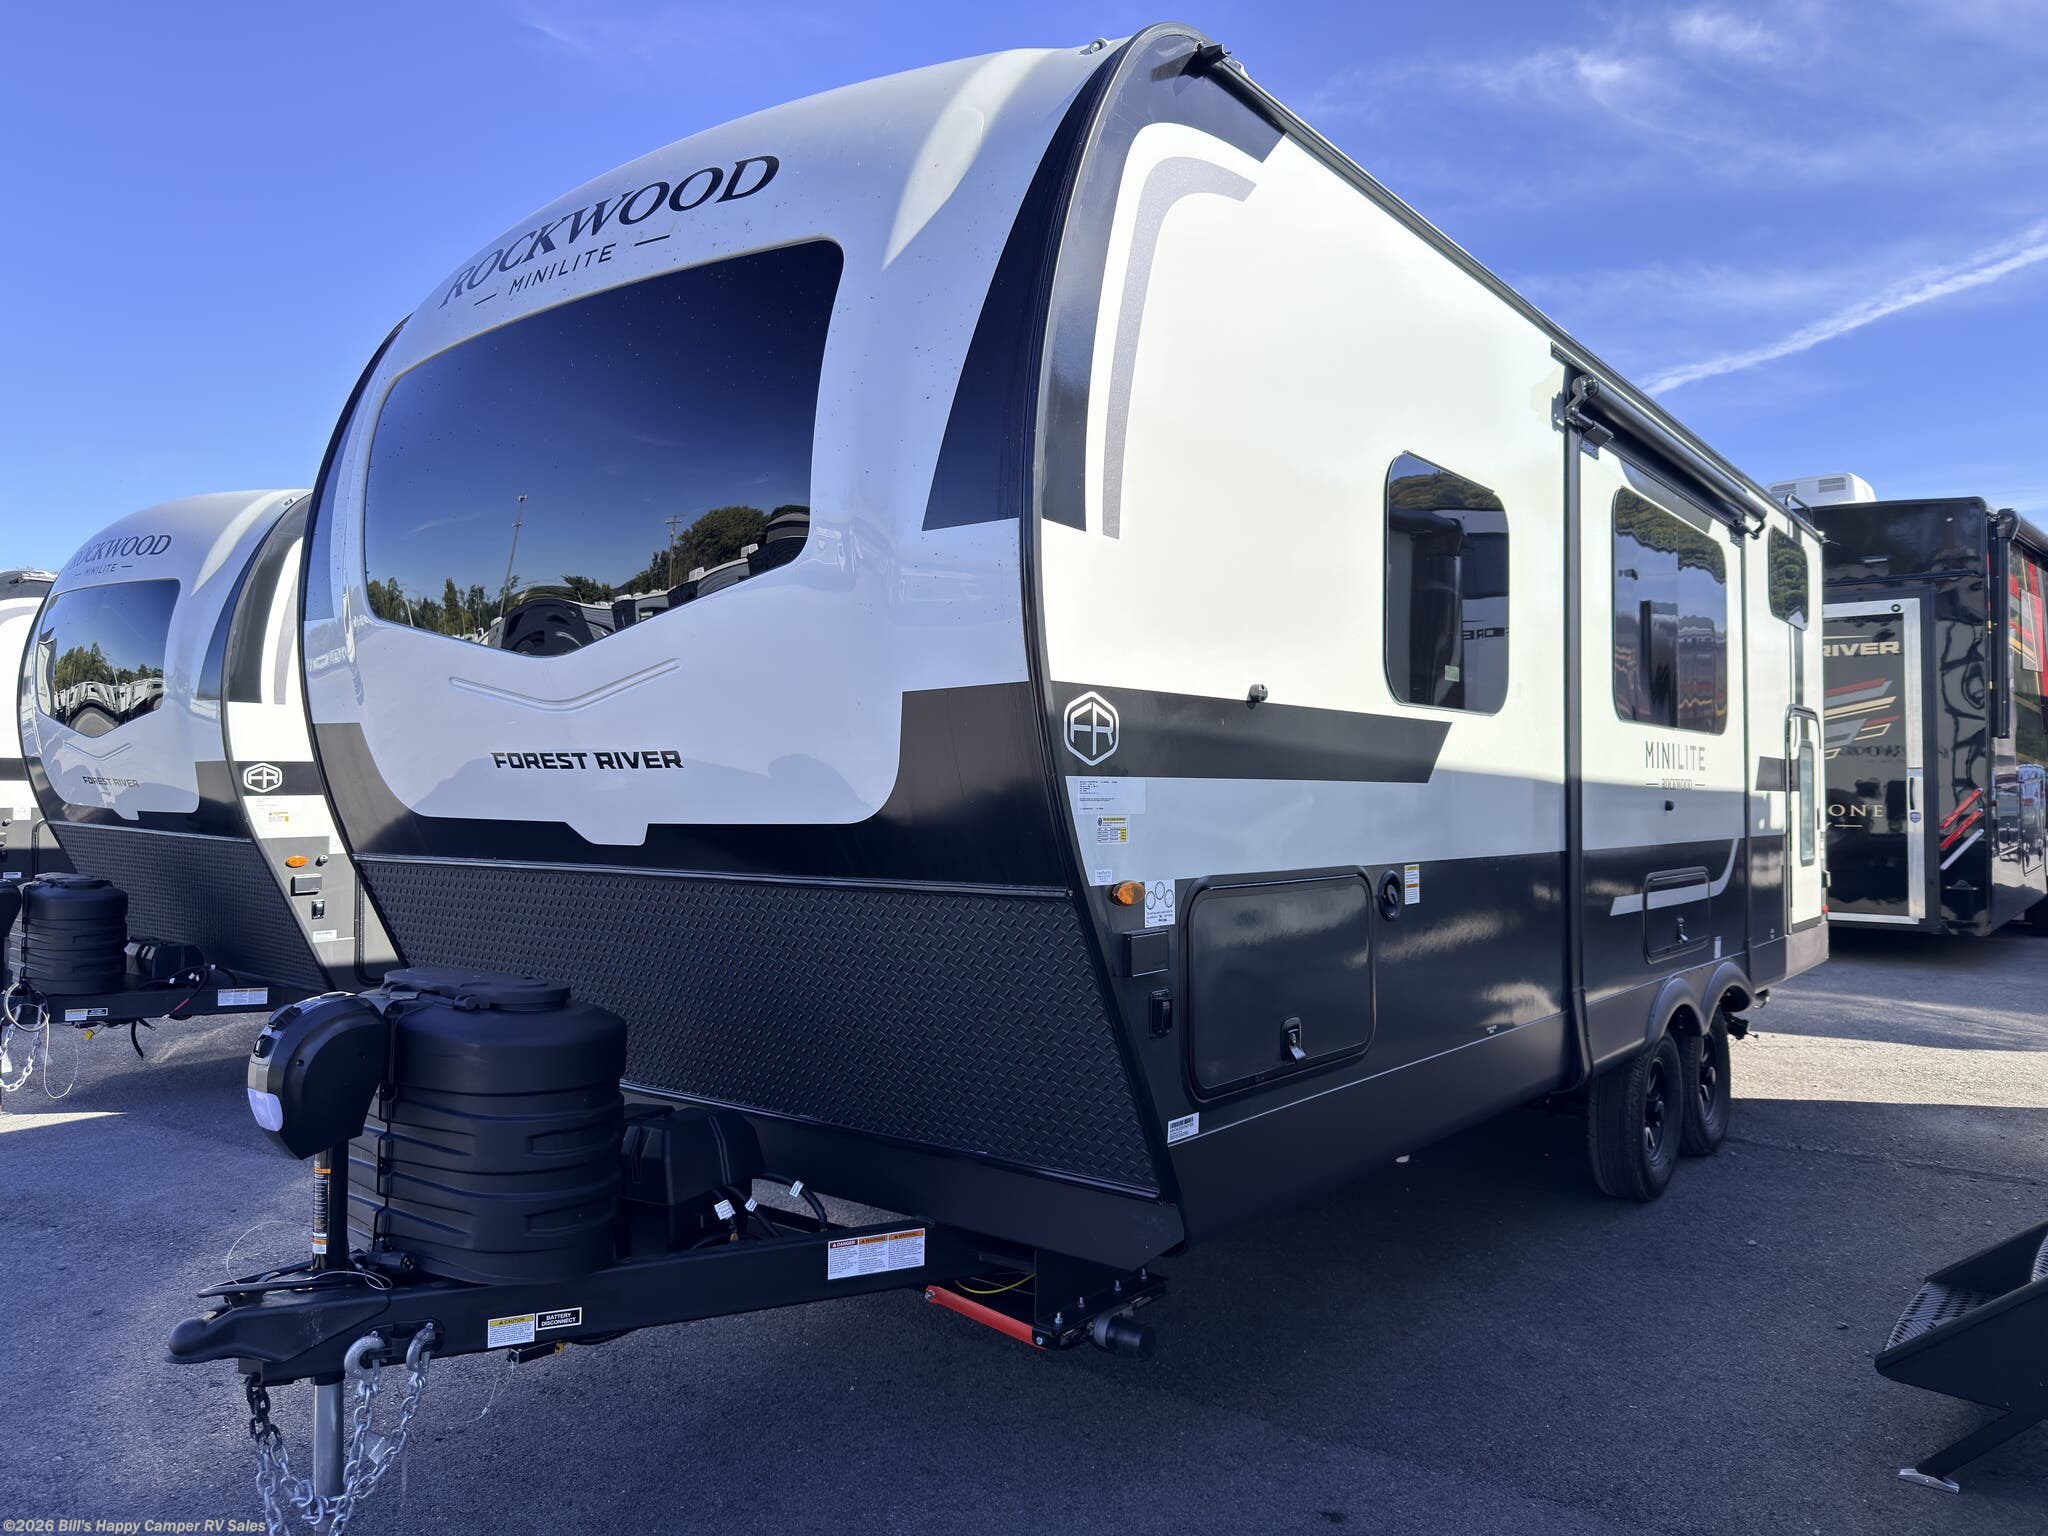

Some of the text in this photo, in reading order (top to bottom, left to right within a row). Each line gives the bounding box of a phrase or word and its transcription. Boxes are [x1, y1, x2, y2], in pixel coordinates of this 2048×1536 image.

[439, 155, 780, 309] ROCKWOOD
[508, 243, 617, 295] MINILITE
[490, 750, 685, 770] FOREST RIVER
[1645, 741, 1705, 771] MINILITE
[82, 776, 140, 788] FOREST RIVER
[1828, 804, 1884, 817] ONE
[541, 1317, 577, 1327] DISCONNECT
[546, 1312, 572, 1321] BATTERY
